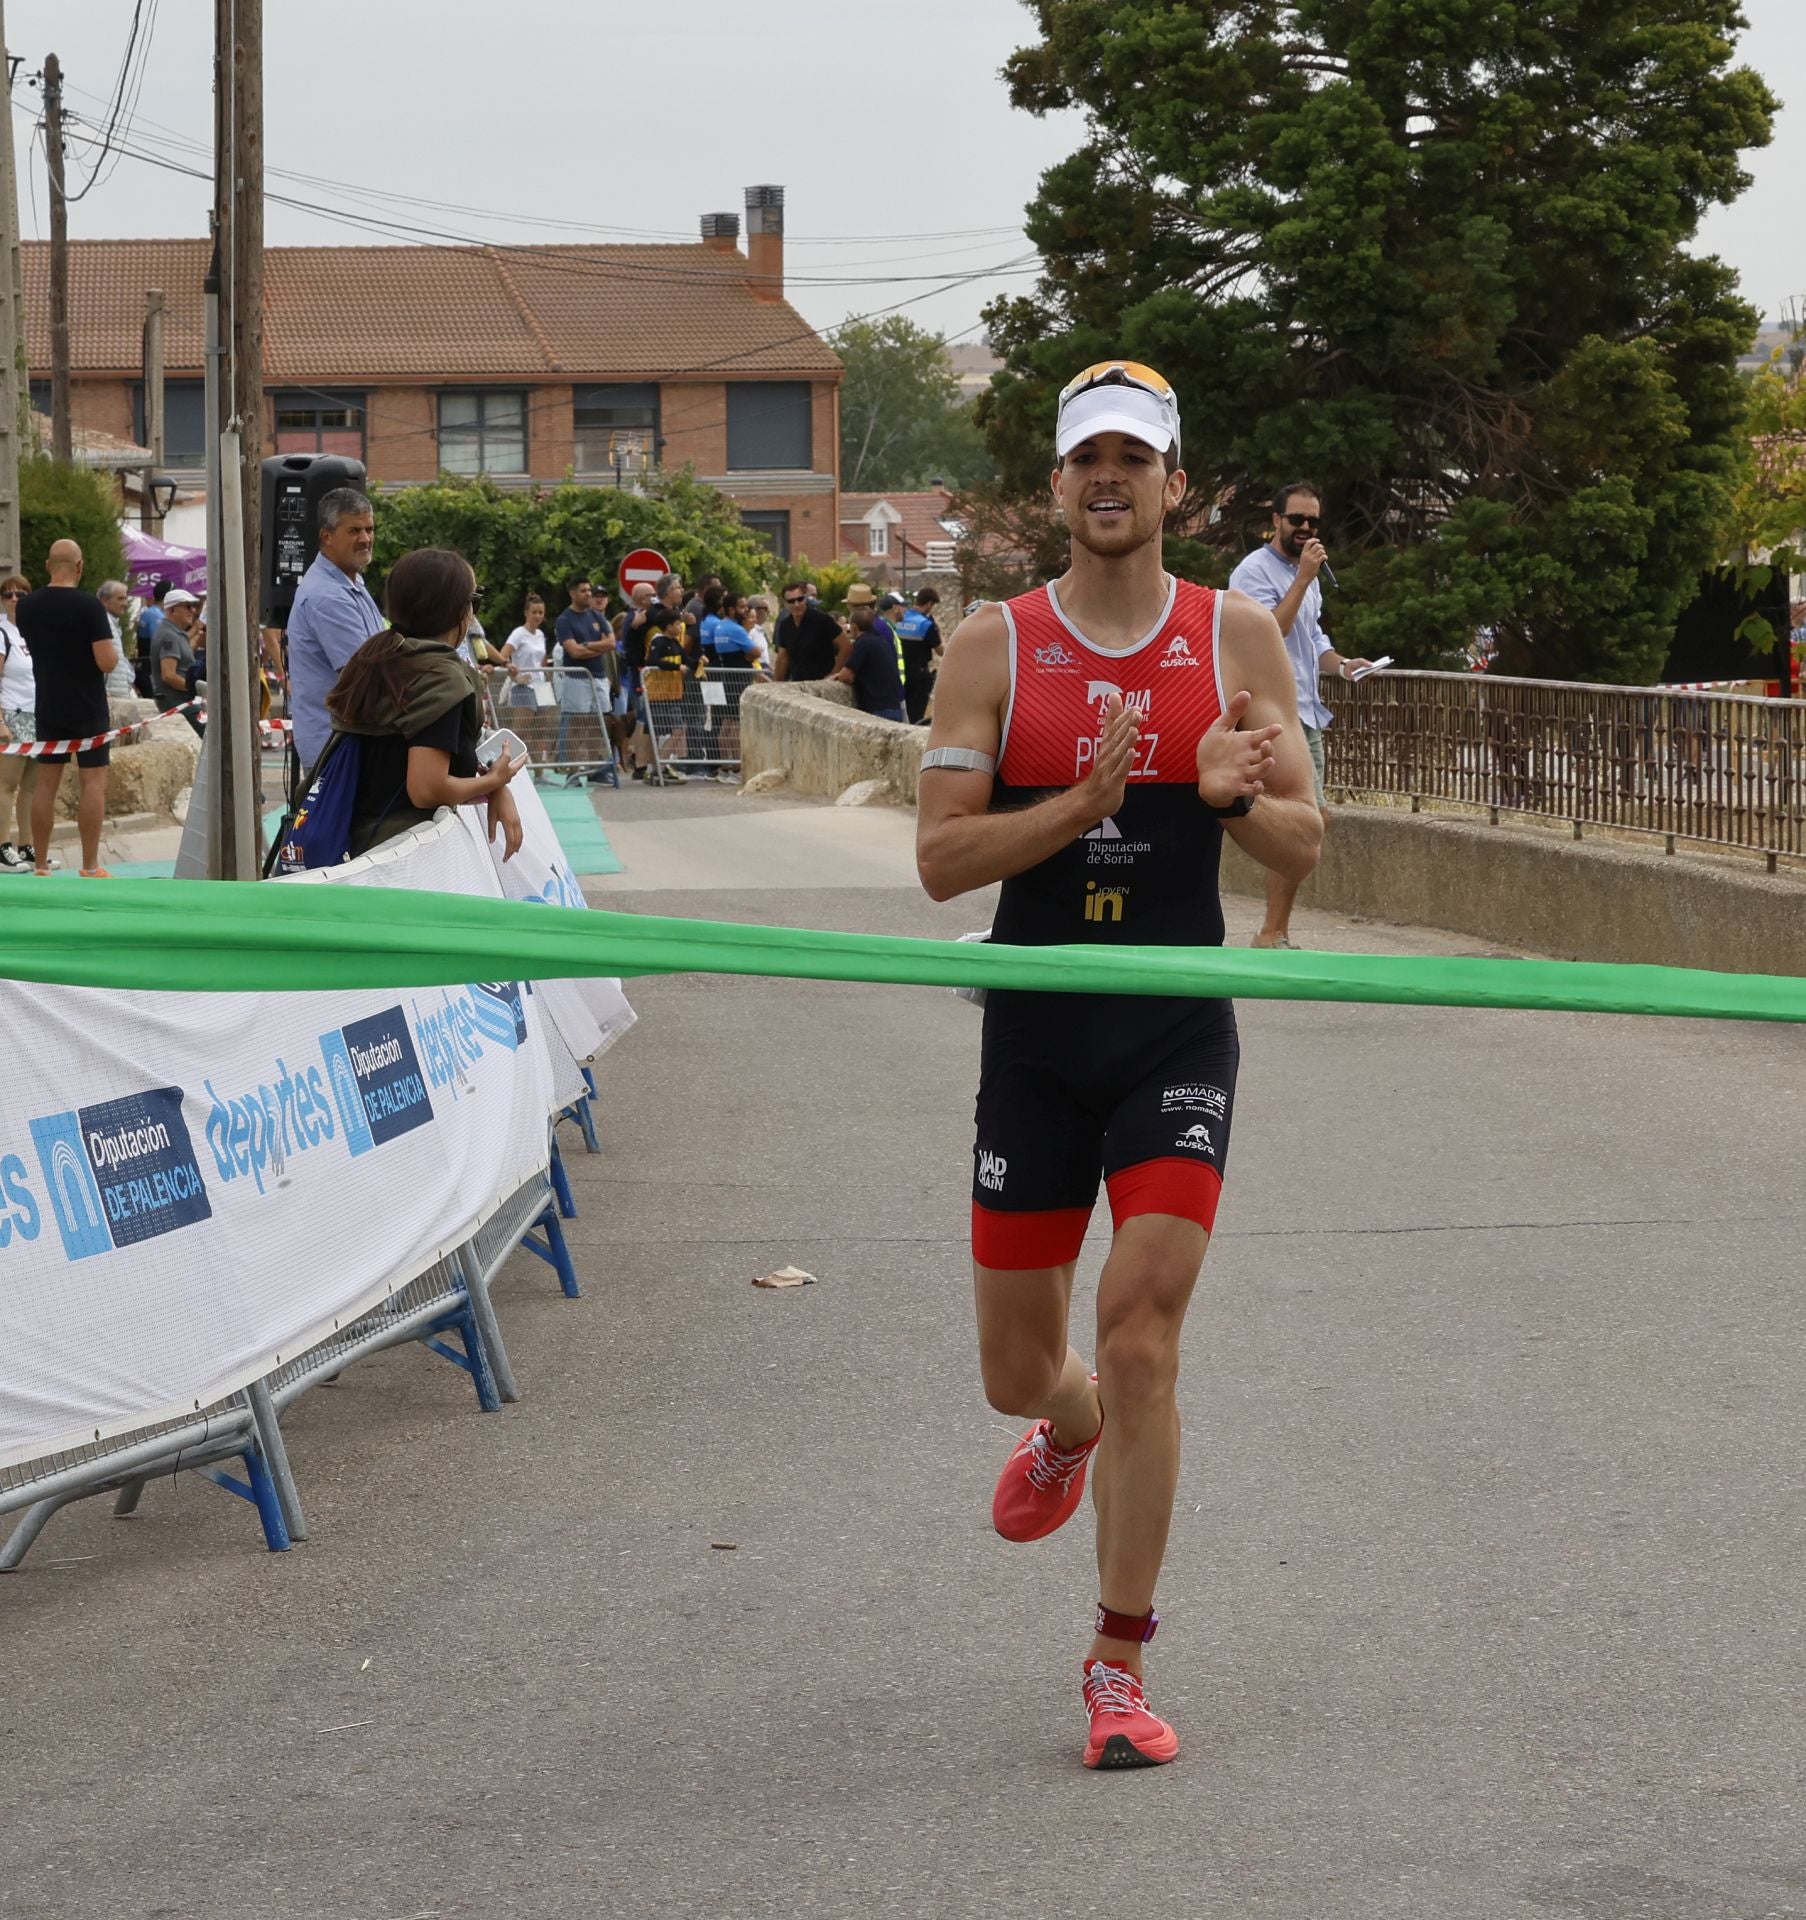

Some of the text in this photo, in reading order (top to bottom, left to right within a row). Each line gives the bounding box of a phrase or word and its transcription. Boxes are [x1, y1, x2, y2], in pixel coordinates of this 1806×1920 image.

[1086, 852, 1134, 864] de Soria
[1088, 841, 1151, 856] Diputación
[1098, 886, 1130, 896] JOVEN
[350, 1032, 403, 1081] Diputación
[364, 1072, 427, 1123] DE PALENCIA
[1163, 1087, 1227, 1105] NOMADAC
[89, 1116, 171, 1171] Diputación
[203, 1057, 335, 1195] deportes
[104, 1162, 203, 1222] DE PALENCIA
